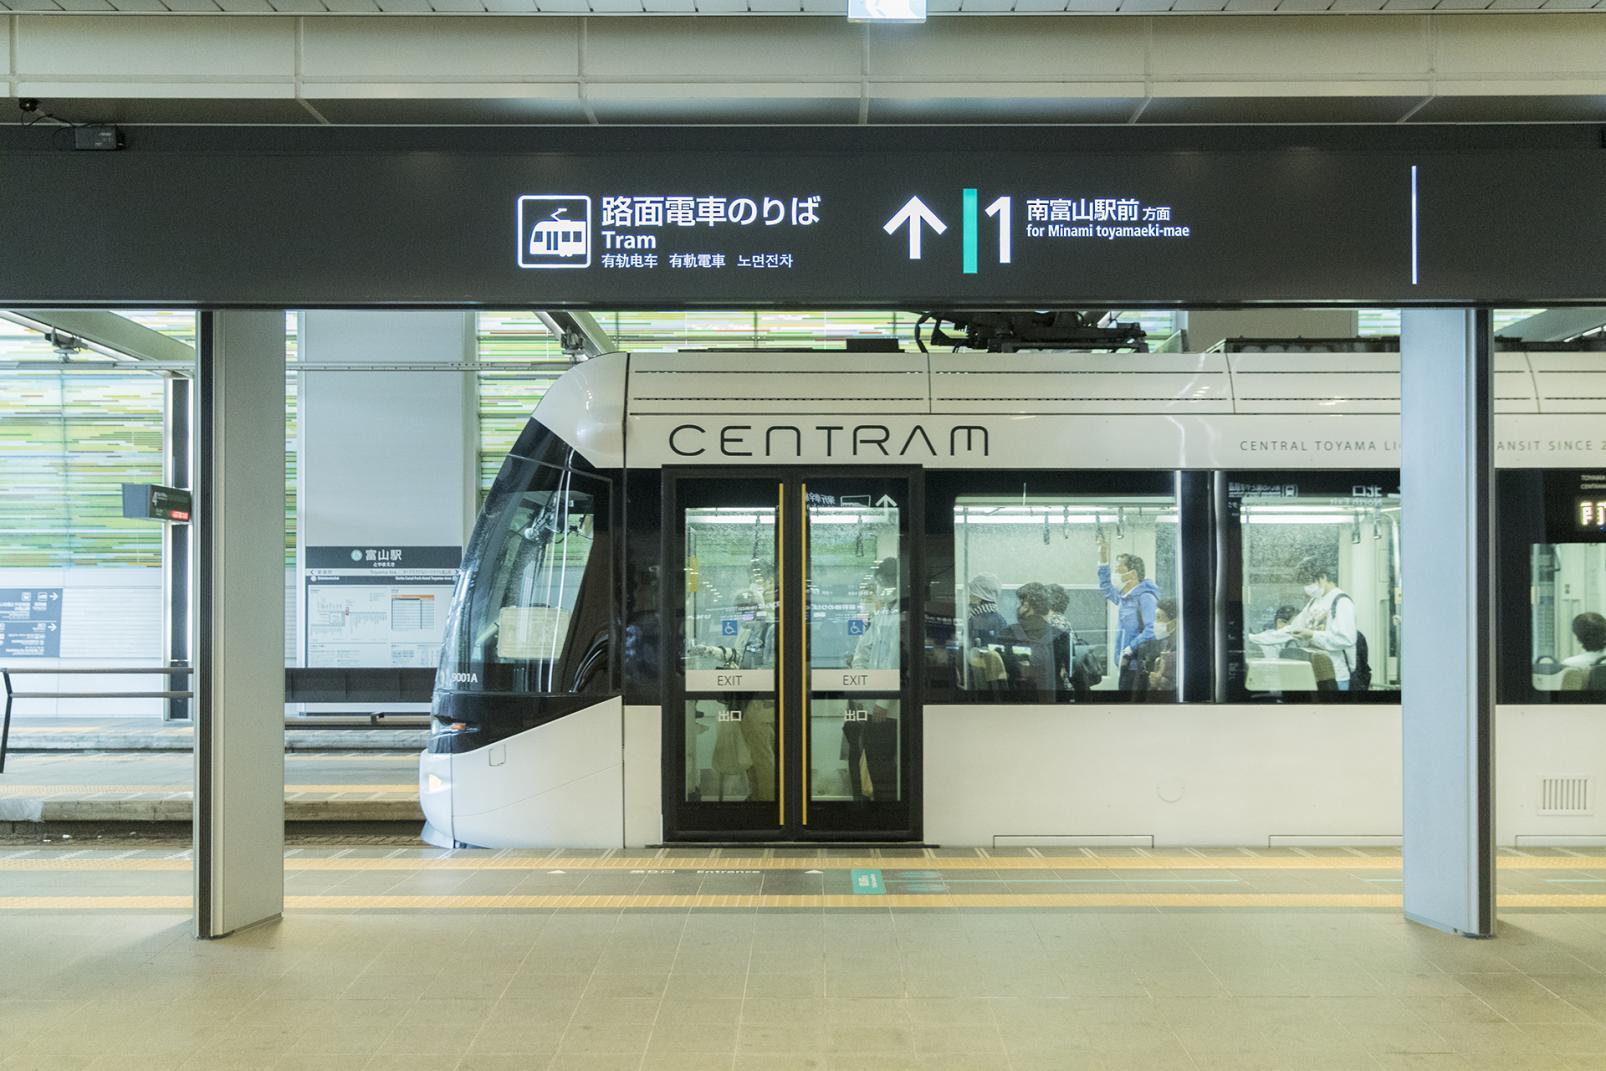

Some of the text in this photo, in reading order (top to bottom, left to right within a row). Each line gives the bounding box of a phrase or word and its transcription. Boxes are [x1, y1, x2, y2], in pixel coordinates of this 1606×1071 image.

[601, 195, 822, 227] 路面電車のりば
[1026, 198, 1172, 222] 南富山駅前 方面
[984, 195, 1011, 264] 1
[1026, 223, 1190, 241] for Minami toyamaeki-mae
[601, 230, 657, 250] Tram
[600, 252, 727, 269] 有轨电车 有軌電車
[736, 253, 794, 269] 노면전차
[668, 424, 989, 457] CENTRAM
[1239, 440, 1308, 451] CENTRAL
[1314, 440, 1377, 451] TOYAMA
[1384, 440, 1401, 451] LI
[1548, 440, 1593, 451] SINCE
[365, 549, 402, 561] 富山駅
[717, 675, 743, 687] EXIT
[842, 674, 869, 686] EXIT
[718, 710, 742, 722] 出口
[844, 710, 868, 722] 出口
